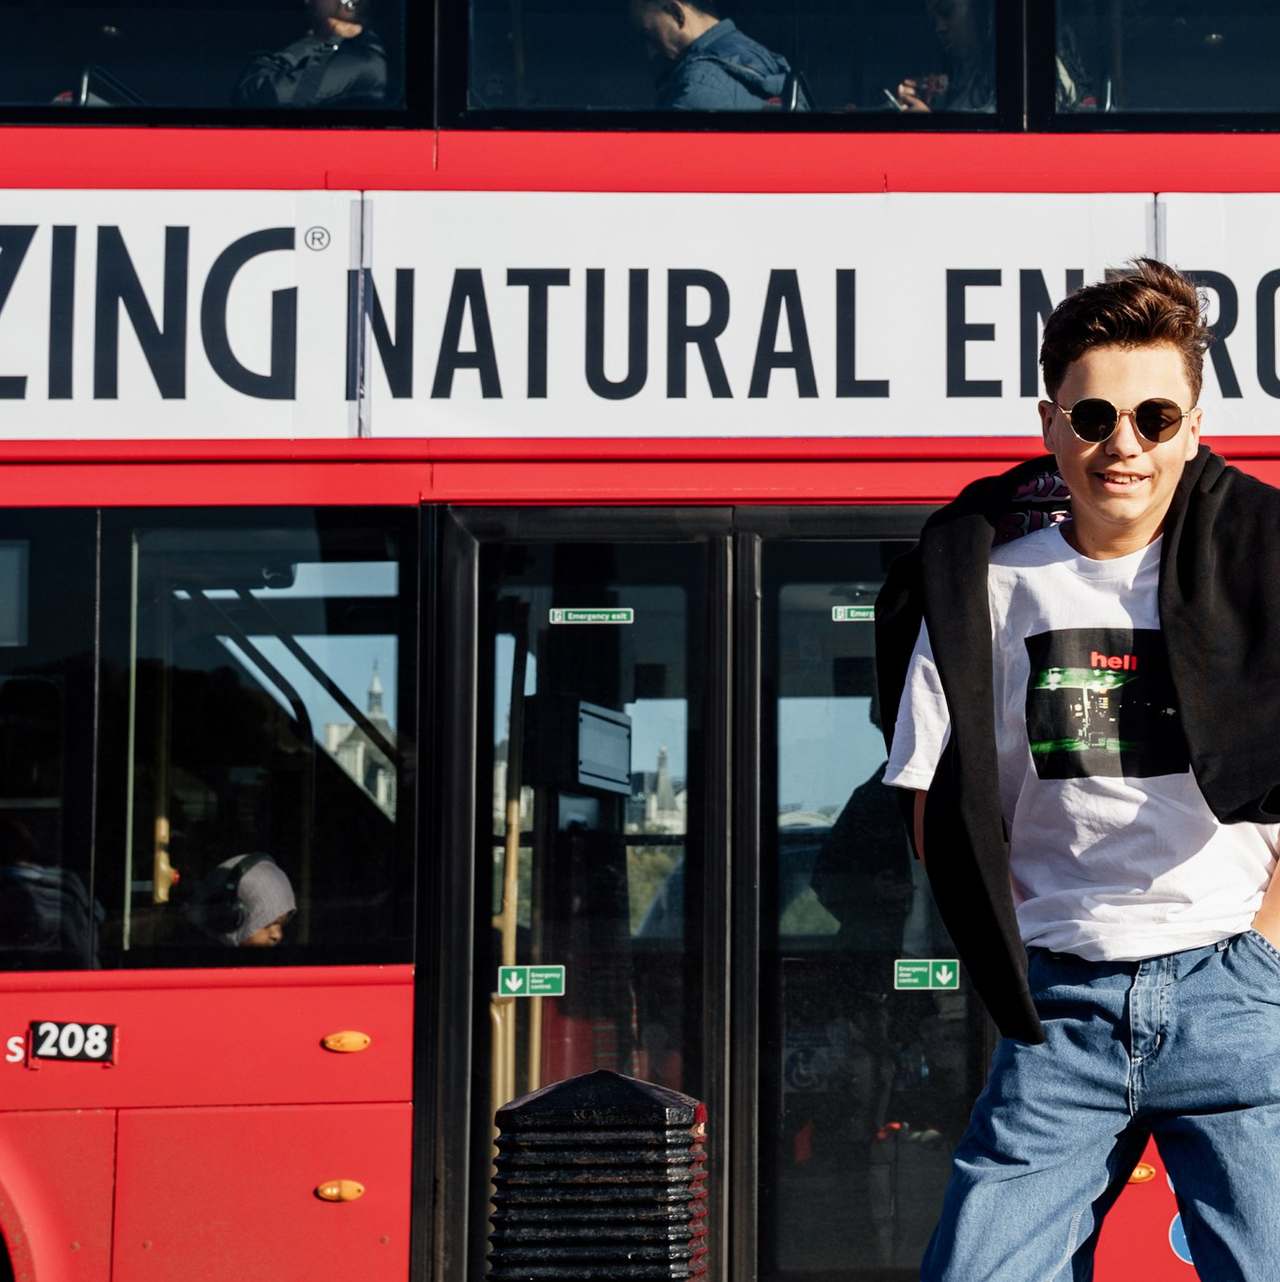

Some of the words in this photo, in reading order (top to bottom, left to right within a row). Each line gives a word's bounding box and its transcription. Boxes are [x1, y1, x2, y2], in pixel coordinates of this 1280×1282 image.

[345, 268, 890, 402] NATURAL
[567, 612, 610, 621] Emergency
[1090, 651, 1138, 671] hell
[5, 1036, 25, 1063] S
[37, 1021, 108, 1058] 208
